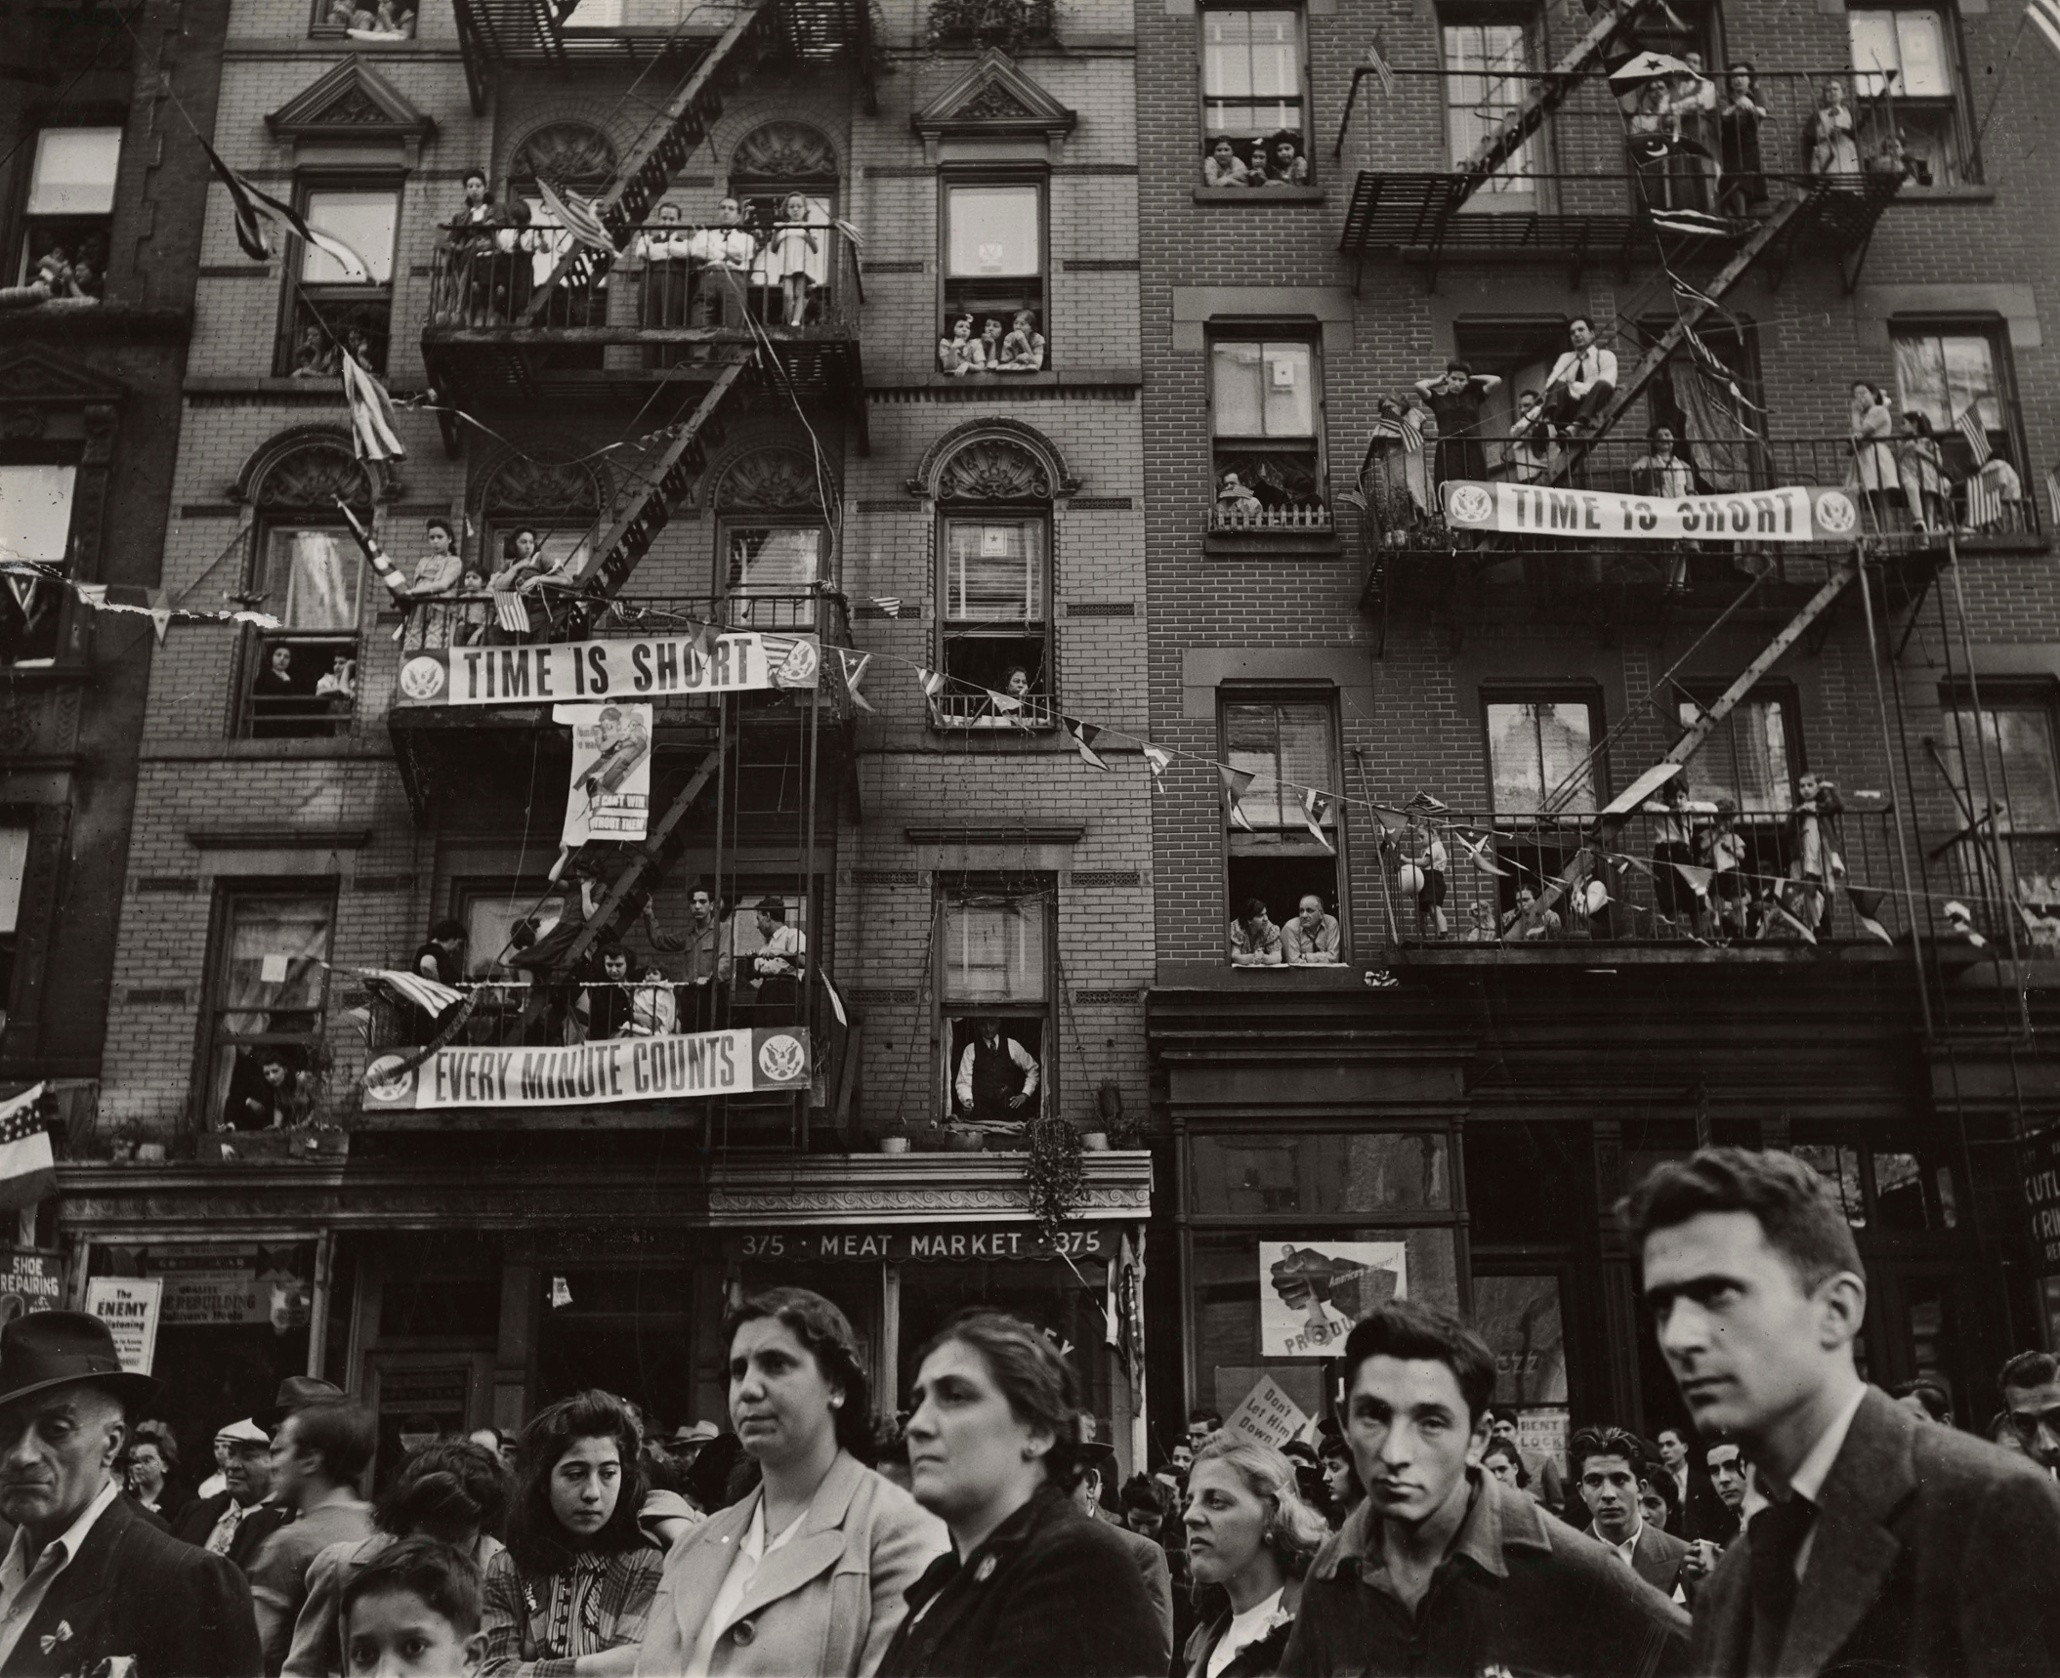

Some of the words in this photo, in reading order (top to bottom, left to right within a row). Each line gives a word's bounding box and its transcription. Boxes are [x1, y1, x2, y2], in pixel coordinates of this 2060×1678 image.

[1512, 487, 1602, 530] TIME
[1621, 499, 1657, 530] IS
[1676, 492, 1795, 534] SHORT
[463, 648, 554, 700] TIME
[572, 644, 609, 695] IS
[631, 638, 753, 692] SHORT
[435, 1051, 513, 1103] EVERY
[520, 1044, 623, 1100] MINUTE
[633, 1034, 736, 1094] COUNTS
[742, 1235, 786, 1256] 375
[820, 1234, 892, 1256] MEAT
[911, 1233, 1022, 1255] MARKET
[1054, 1231, 1101, 1253] 375
[13, 1256, 43, 1276] SHOE
[0, 1273, 59, 1297] REPAIRING
[116, 1289, 132, 1299] The
[97, 1301, 148, 1316] ENEMY
[176, 1294, 256, 1309] REBUILDING
[1264, 1388, 1292, 1418] Don't
[1238, 1416, 1281, 1447] Down!
[1246, 1398, 1266, 1418] Let
[1267, 1414, 1291, 1439] Him
